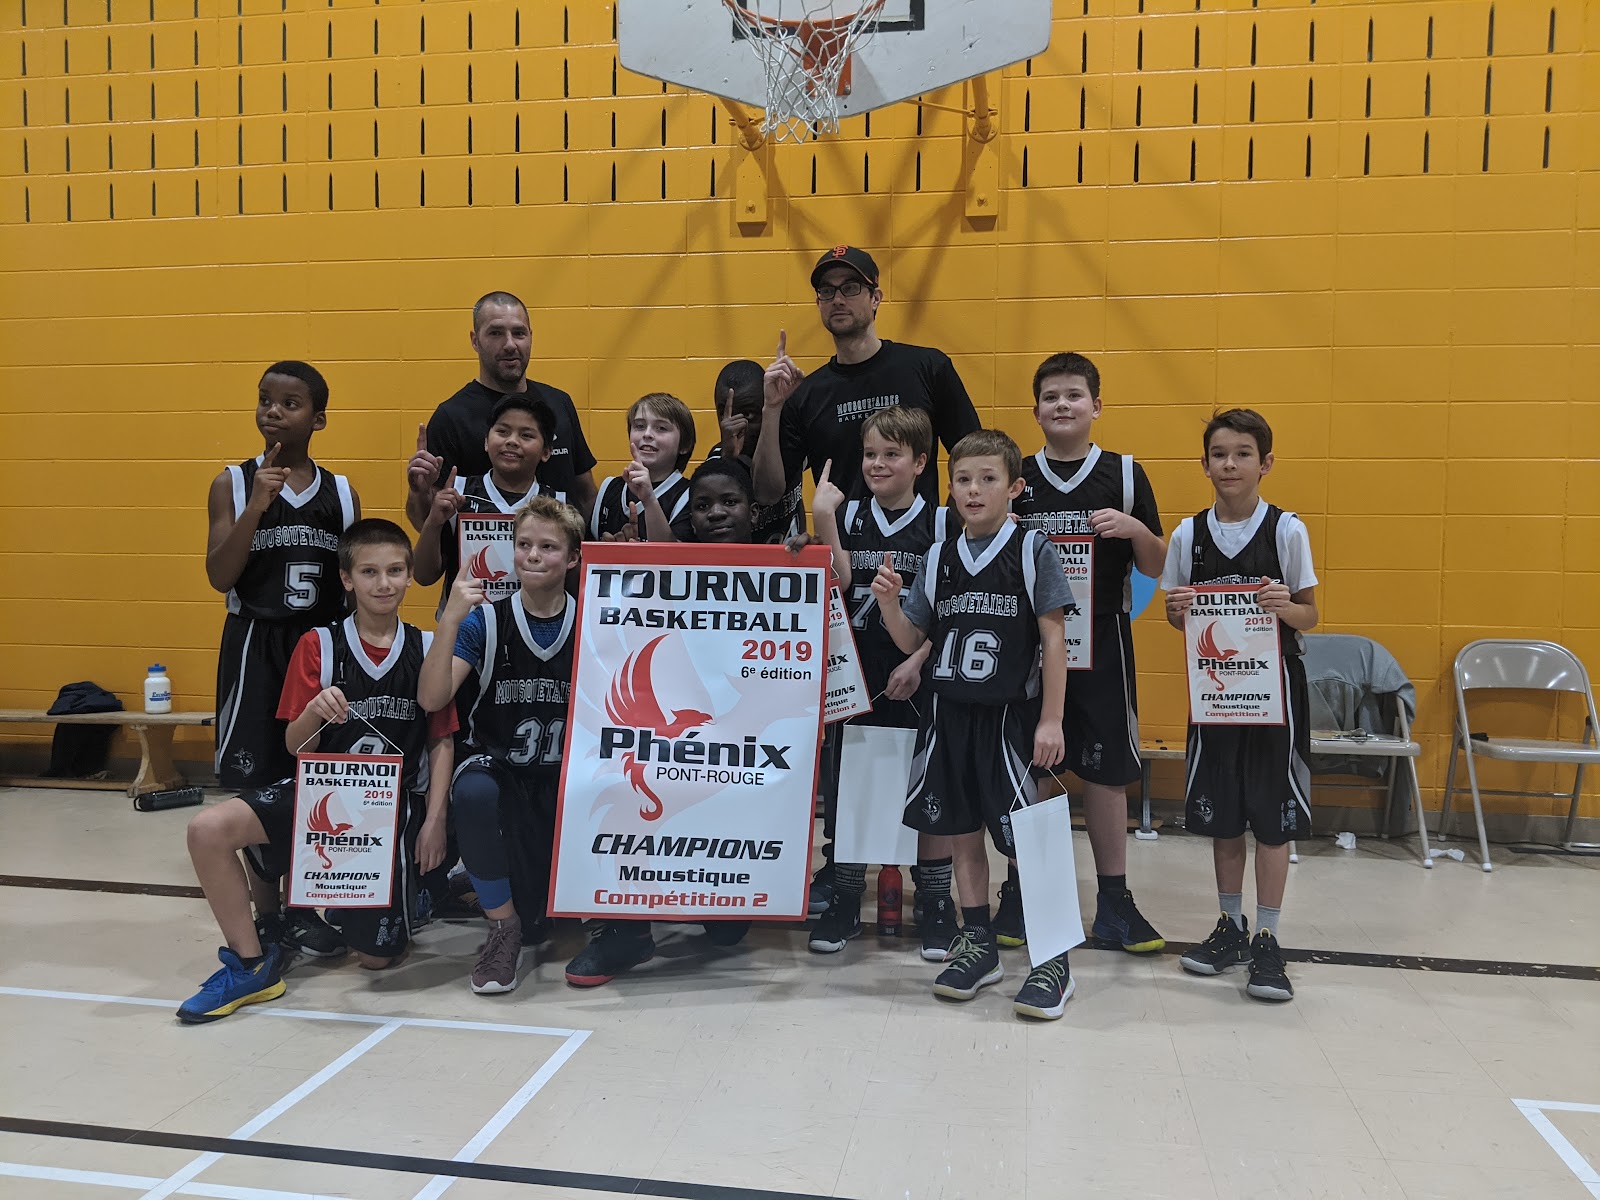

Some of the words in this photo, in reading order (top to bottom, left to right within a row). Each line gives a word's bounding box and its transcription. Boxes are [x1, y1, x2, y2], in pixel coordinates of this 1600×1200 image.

[1063, 566, 1088, 575] 2019
[284, 561, 323, 611] 5
[591, 569, 819, 604] TOURNOI
[599, 607, 808, 633] BASKETBALL
[1244, 617, 1273, 626] 2019
[741, 639, 813, 662] 2019
[932, 628, 1002, 683] 16
[1197, 658, 1270, 670] Phénix
[761, 666, 812, 680] édition
[1201, 693, 1271, 701] CHAMPIONS
[1204, 710, 1260, 718] Compétition
[505, 716, 566, 766] 31
[599, 726, 793, 770] Phénix
[302, 762, 398, 777] TOURNOI
[656, 767, 765, 786] PONT-ROUGE
[305, 777, 392, 788] BASKETBALL
[364, 790, 394, 800] 2019
[305, 832, 384, 847] Phénix
[591, 833, 784, 861] CHAMPIONS
[304, 871, 380, 881] CHAMPIONS
[618, 866, 751, 887] Moustique
[594, 889, 746, 909] Compétition
[752, 893, 769, 907] 2
